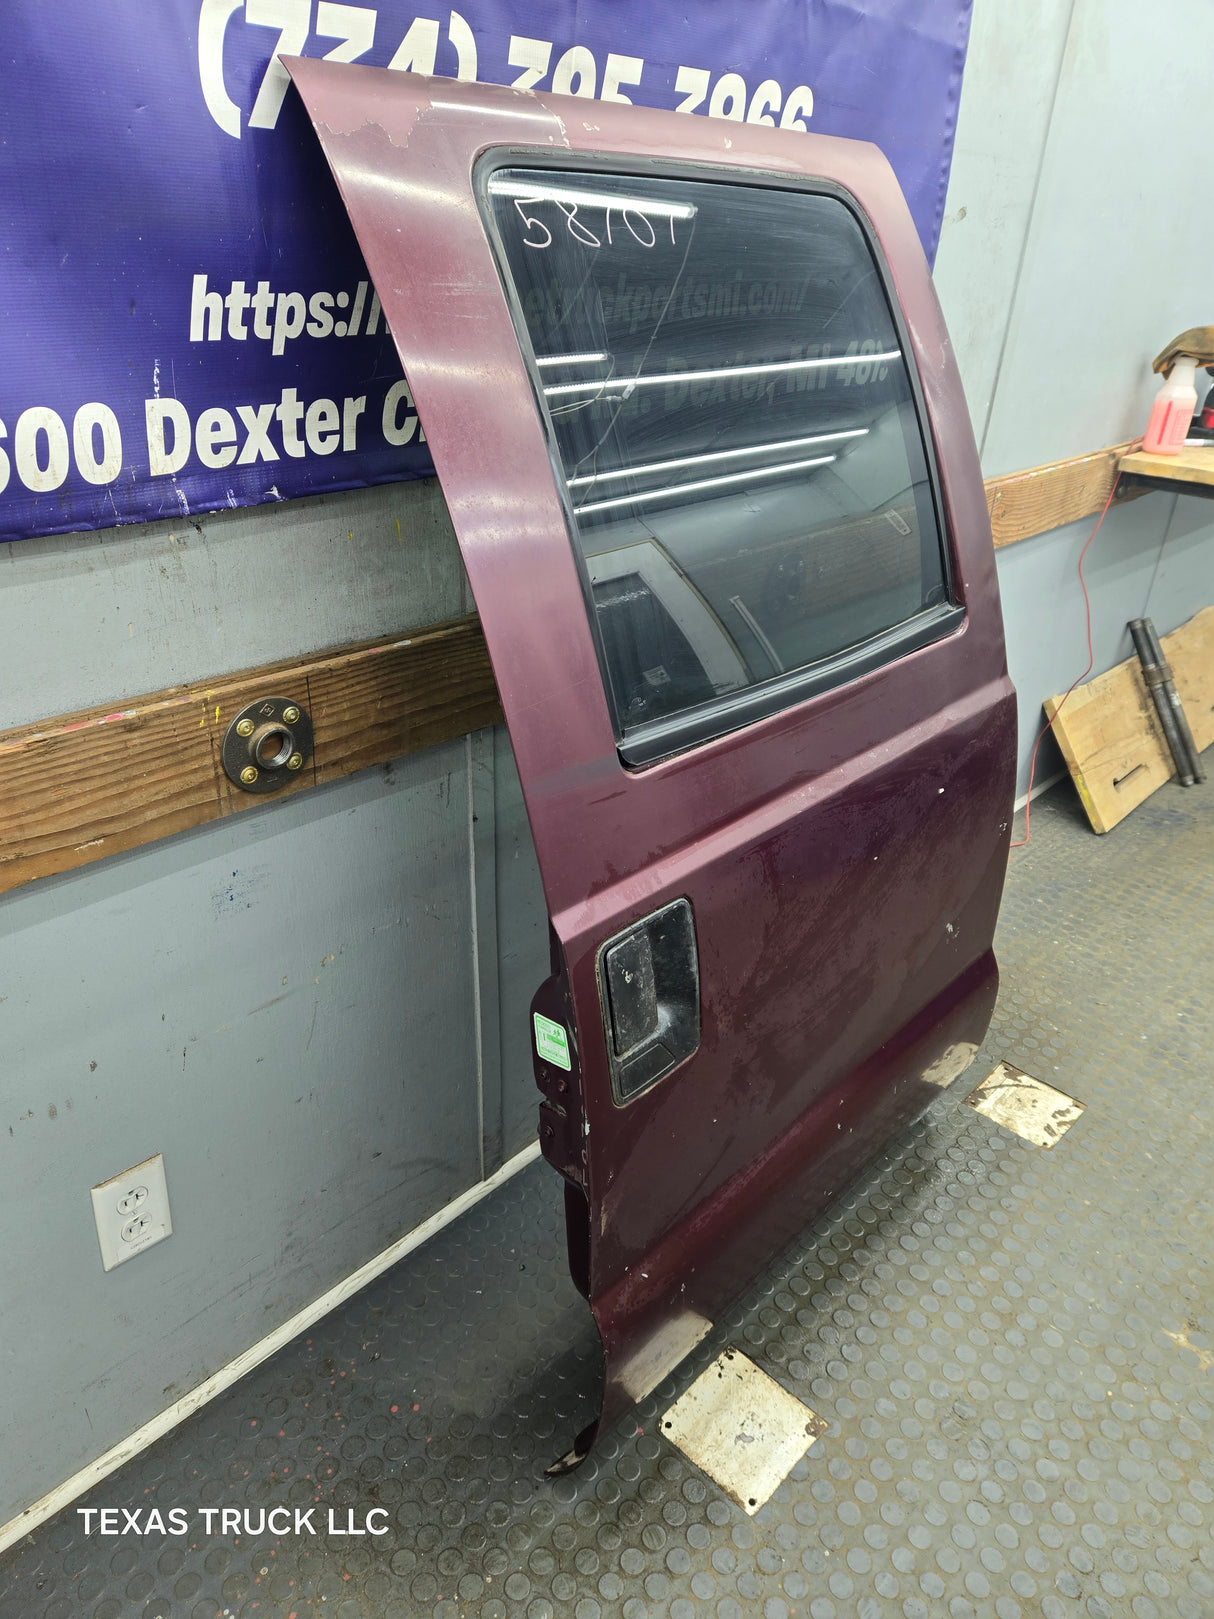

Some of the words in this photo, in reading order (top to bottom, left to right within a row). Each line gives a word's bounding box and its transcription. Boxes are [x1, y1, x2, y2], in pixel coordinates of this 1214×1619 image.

[190, 274, 390, 356] https://
[0, 402, 122, 496] 00
[145, 388, 366, 477] Dexter
[383, 379, 426, 446] C
